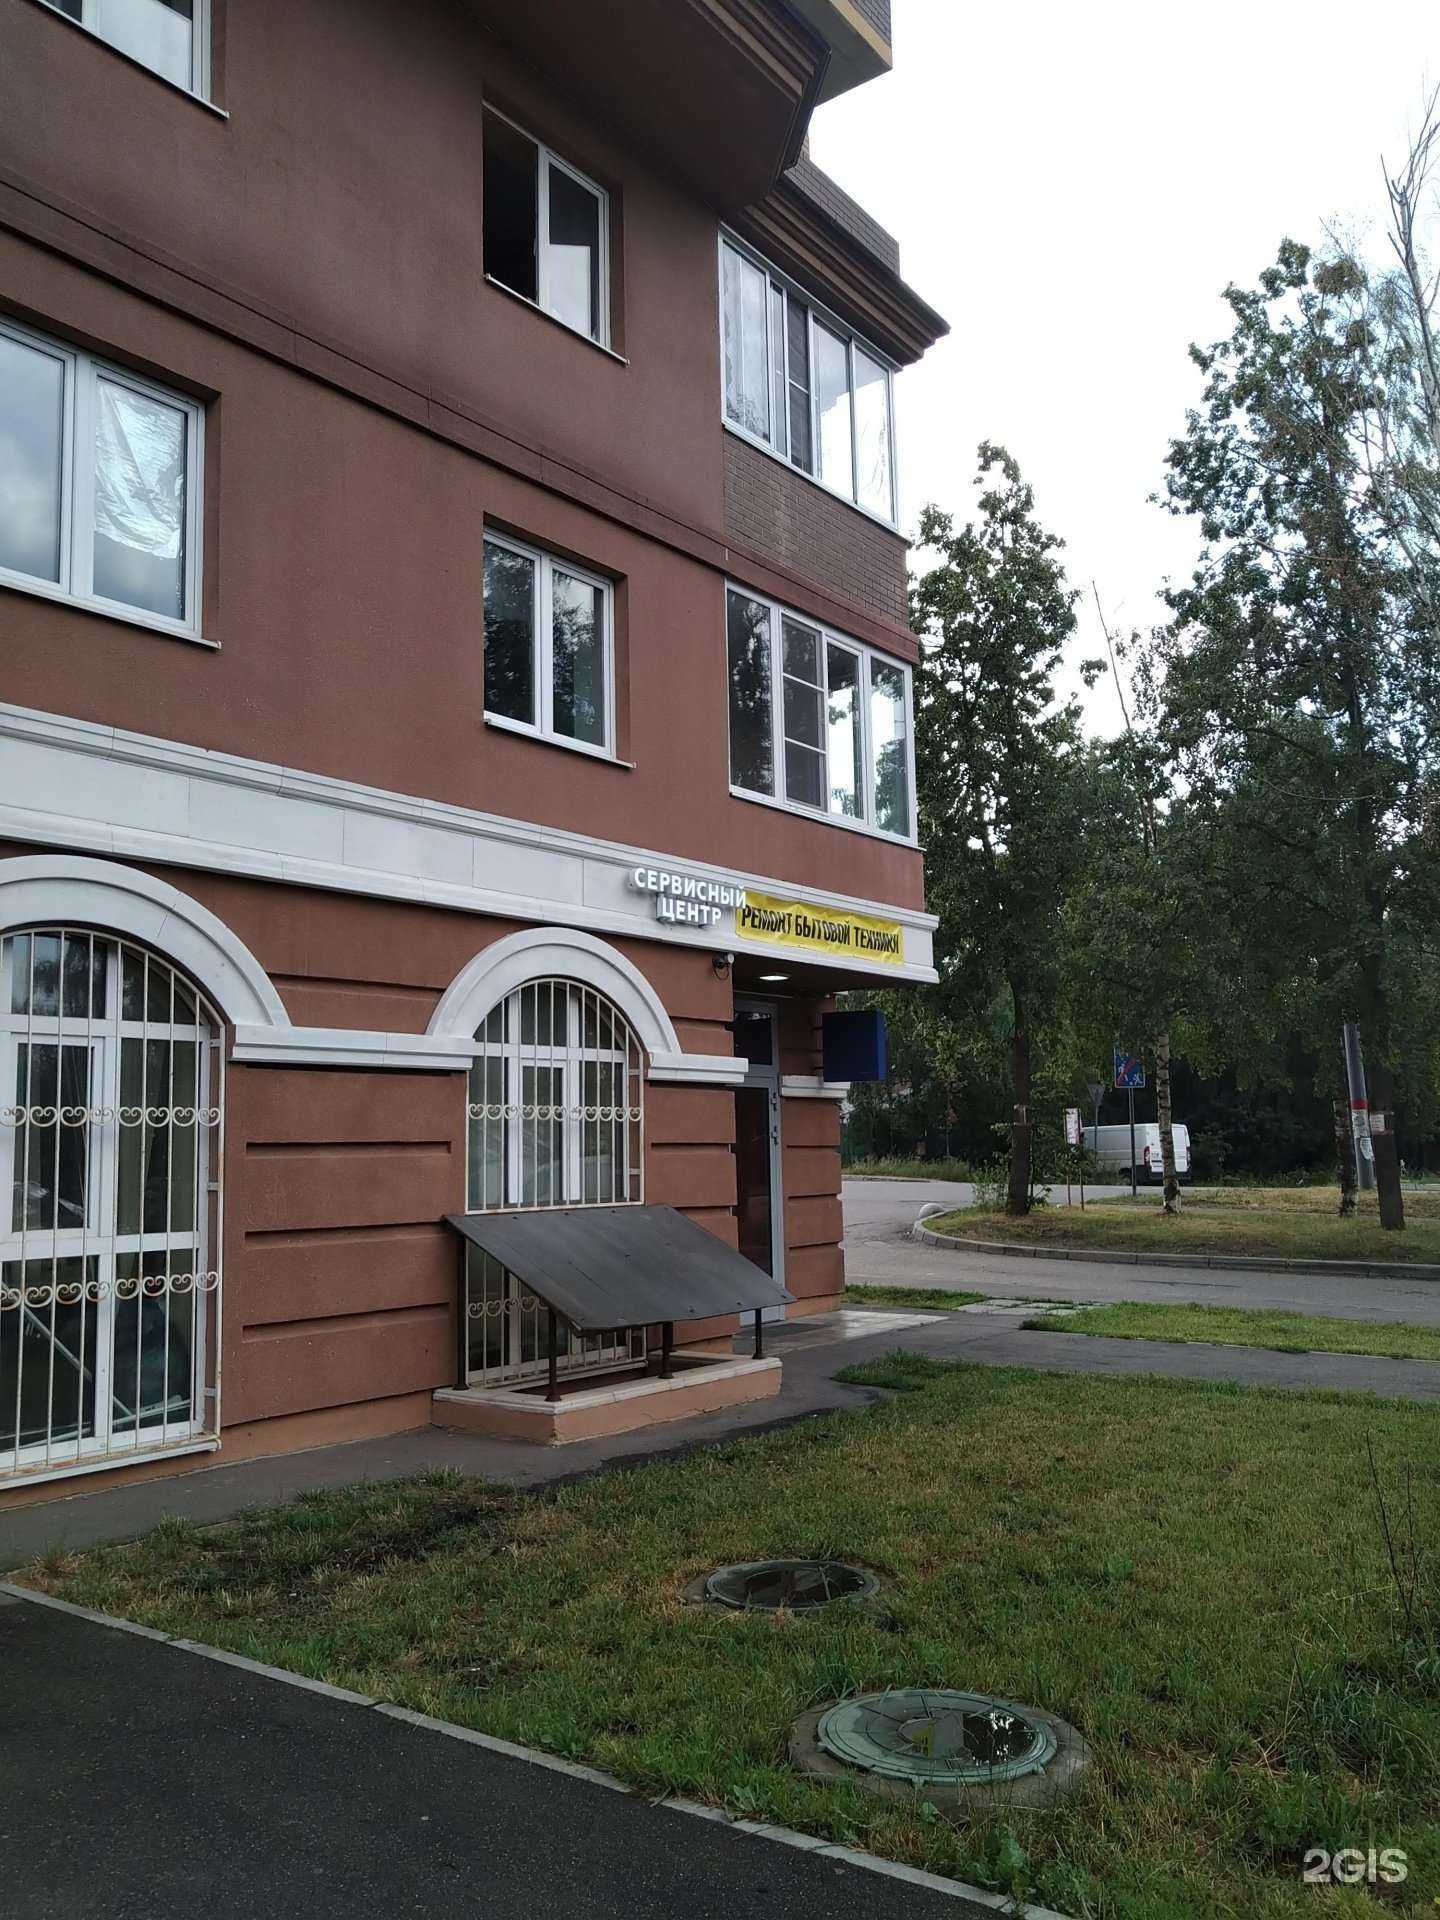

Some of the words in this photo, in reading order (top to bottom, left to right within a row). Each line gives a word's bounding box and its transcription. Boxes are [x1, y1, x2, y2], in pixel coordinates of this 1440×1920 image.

[633, 867, 747, 909] СЕРВИСНЫЙ
[660, 897, 722, 925] ЦЕНТР
[741, 904, 792, 935] РЕМОНТ
[795, 915, 851, 946] БЫТОВОЙ
[854, 926, 900, 954] ТЕХНИКИ
